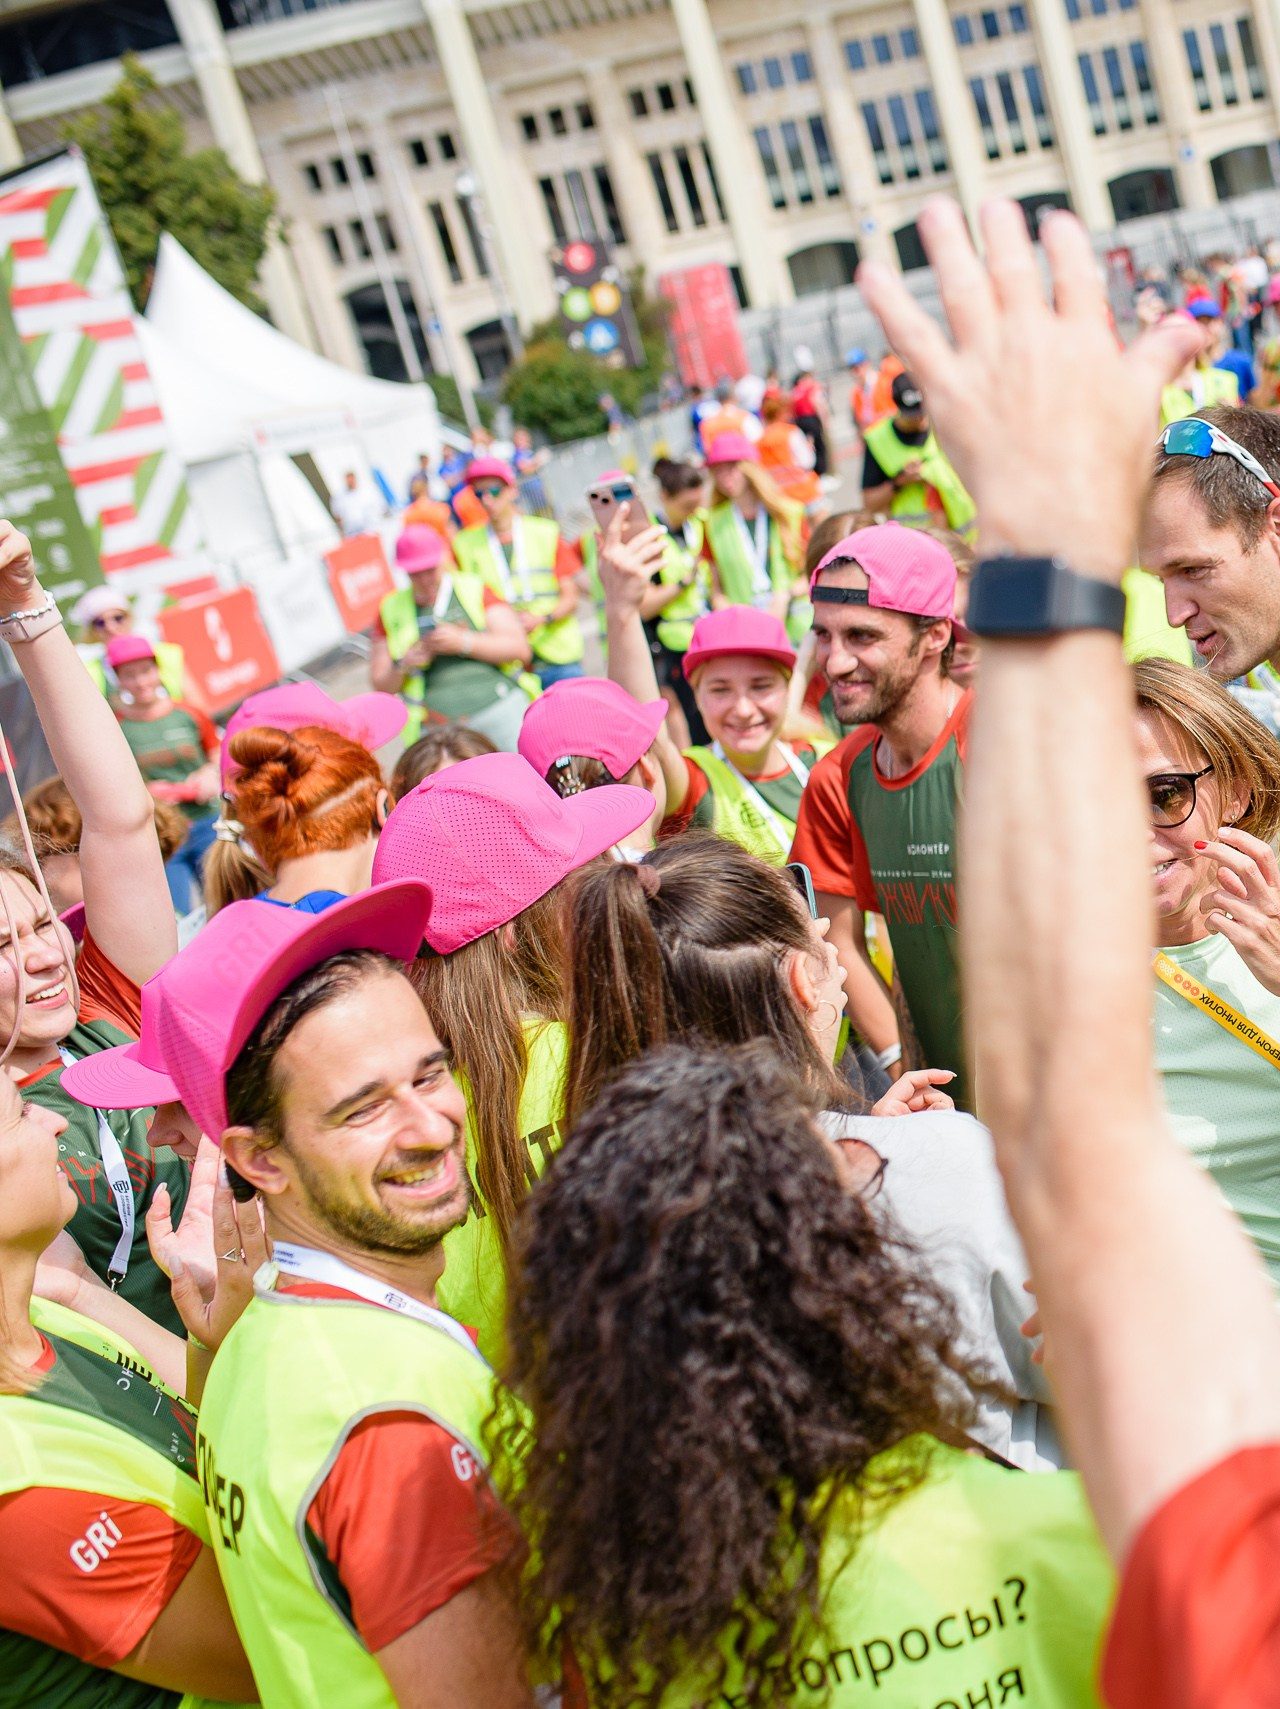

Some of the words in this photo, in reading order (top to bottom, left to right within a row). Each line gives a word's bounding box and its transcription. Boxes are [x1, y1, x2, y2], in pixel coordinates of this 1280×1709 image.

[1199, 993, 1238, 1026] МНОГИХ
[1237, 1021, 1258, 1040] ДЛЯ
[69, 1511, 123, 1573] GRi
